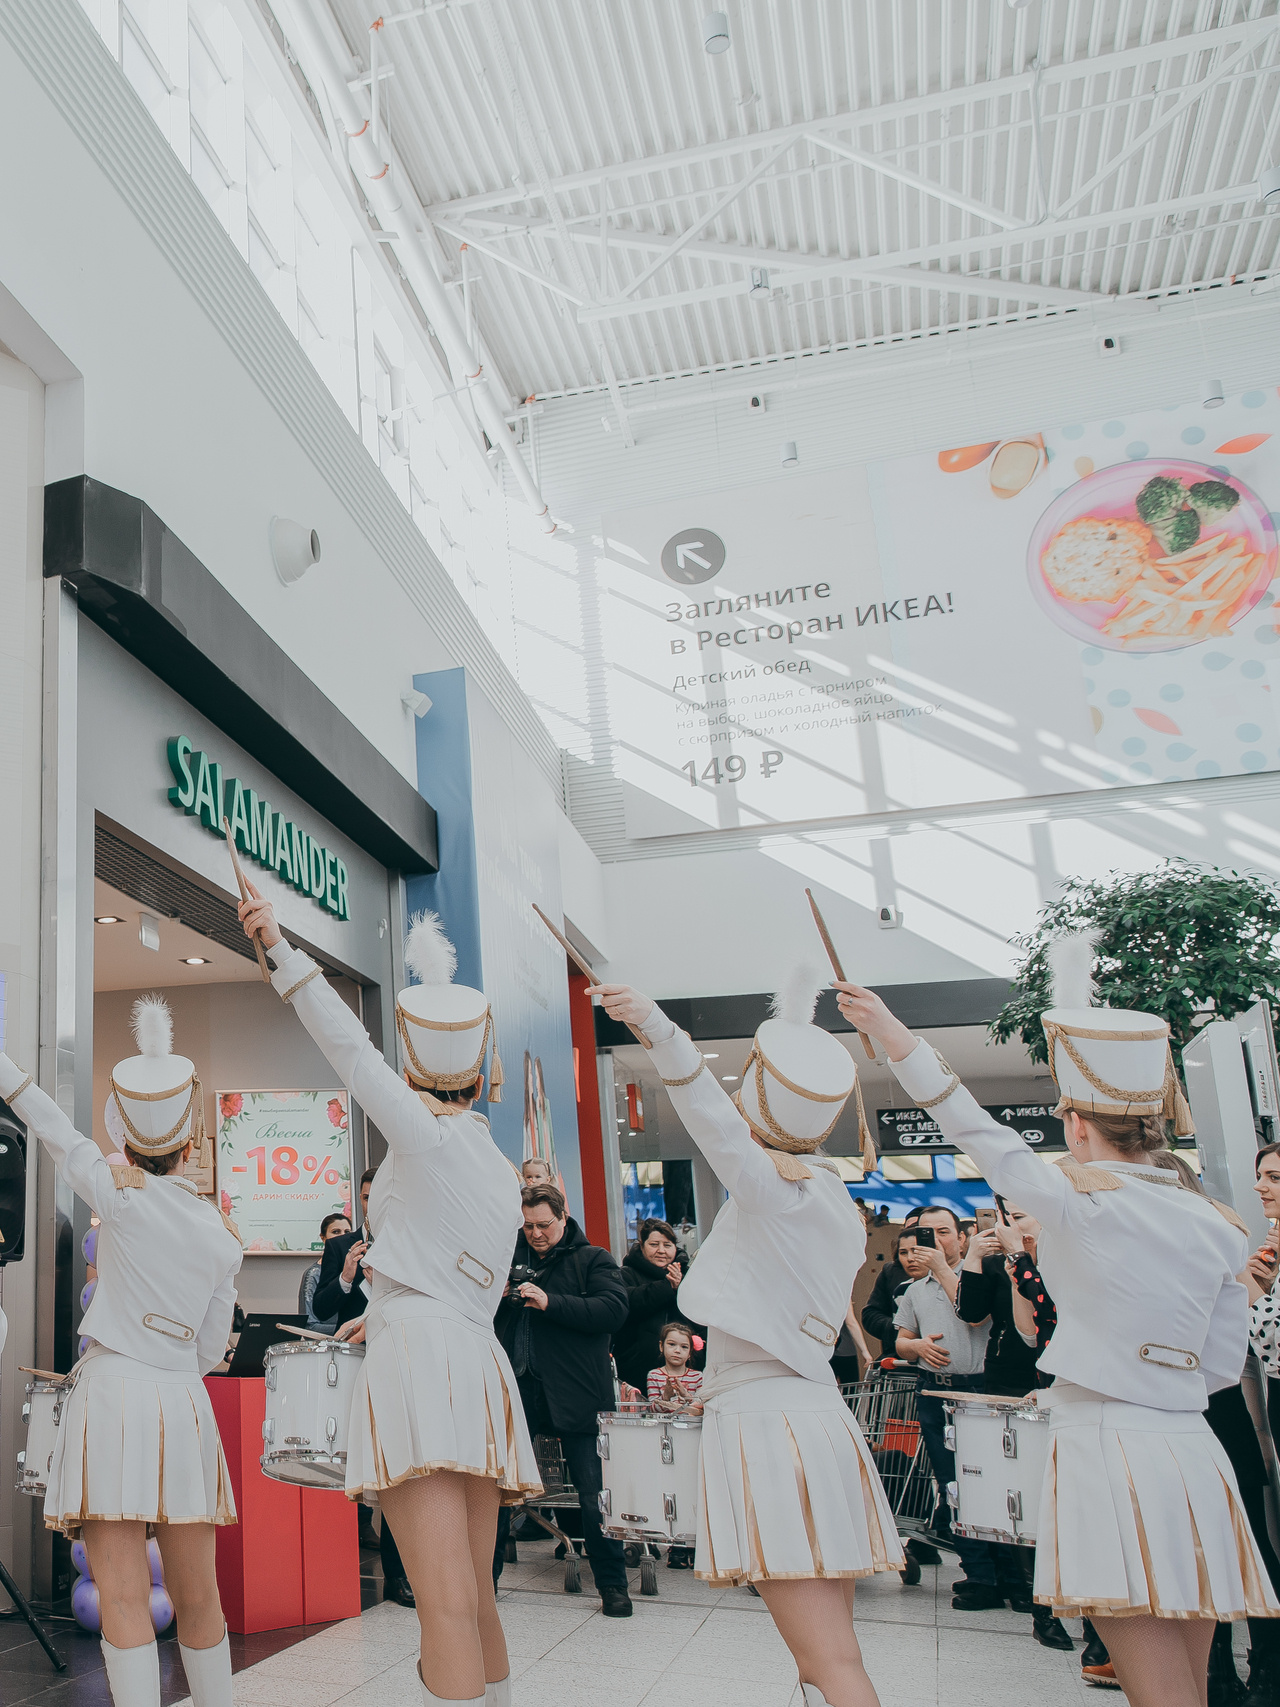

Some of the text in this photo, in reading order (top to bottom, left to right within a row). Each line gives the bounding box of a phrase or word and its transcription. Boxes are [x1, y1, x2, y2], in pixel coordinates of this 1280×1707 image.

[666, 582, 831, 622] Загляните
[669, 592, 955, 655] в Ресторан ИКЕА!
[672, 658, 811, 691] Детский обед
[675, 676, 888, 715] Куриная оладья с гарниром
[677, 690, 893, 730] на выбор, шоколадное яйцо
[678, 701, 944, 746] с сюрпризом и холодный напиток
[681, 754, 747, 787] 149
[167, 734, 352, 921] SALAMANDER
[255, 1120, 313, 1139] Весна
[895, 1111, 925, 1121] ИКЕА
[1016, 1106, 1048, 1117] ИКЕА
[232, 1146, 340, 1186] -18%
[252, 1193, 283, 1201] ДАРИМ
